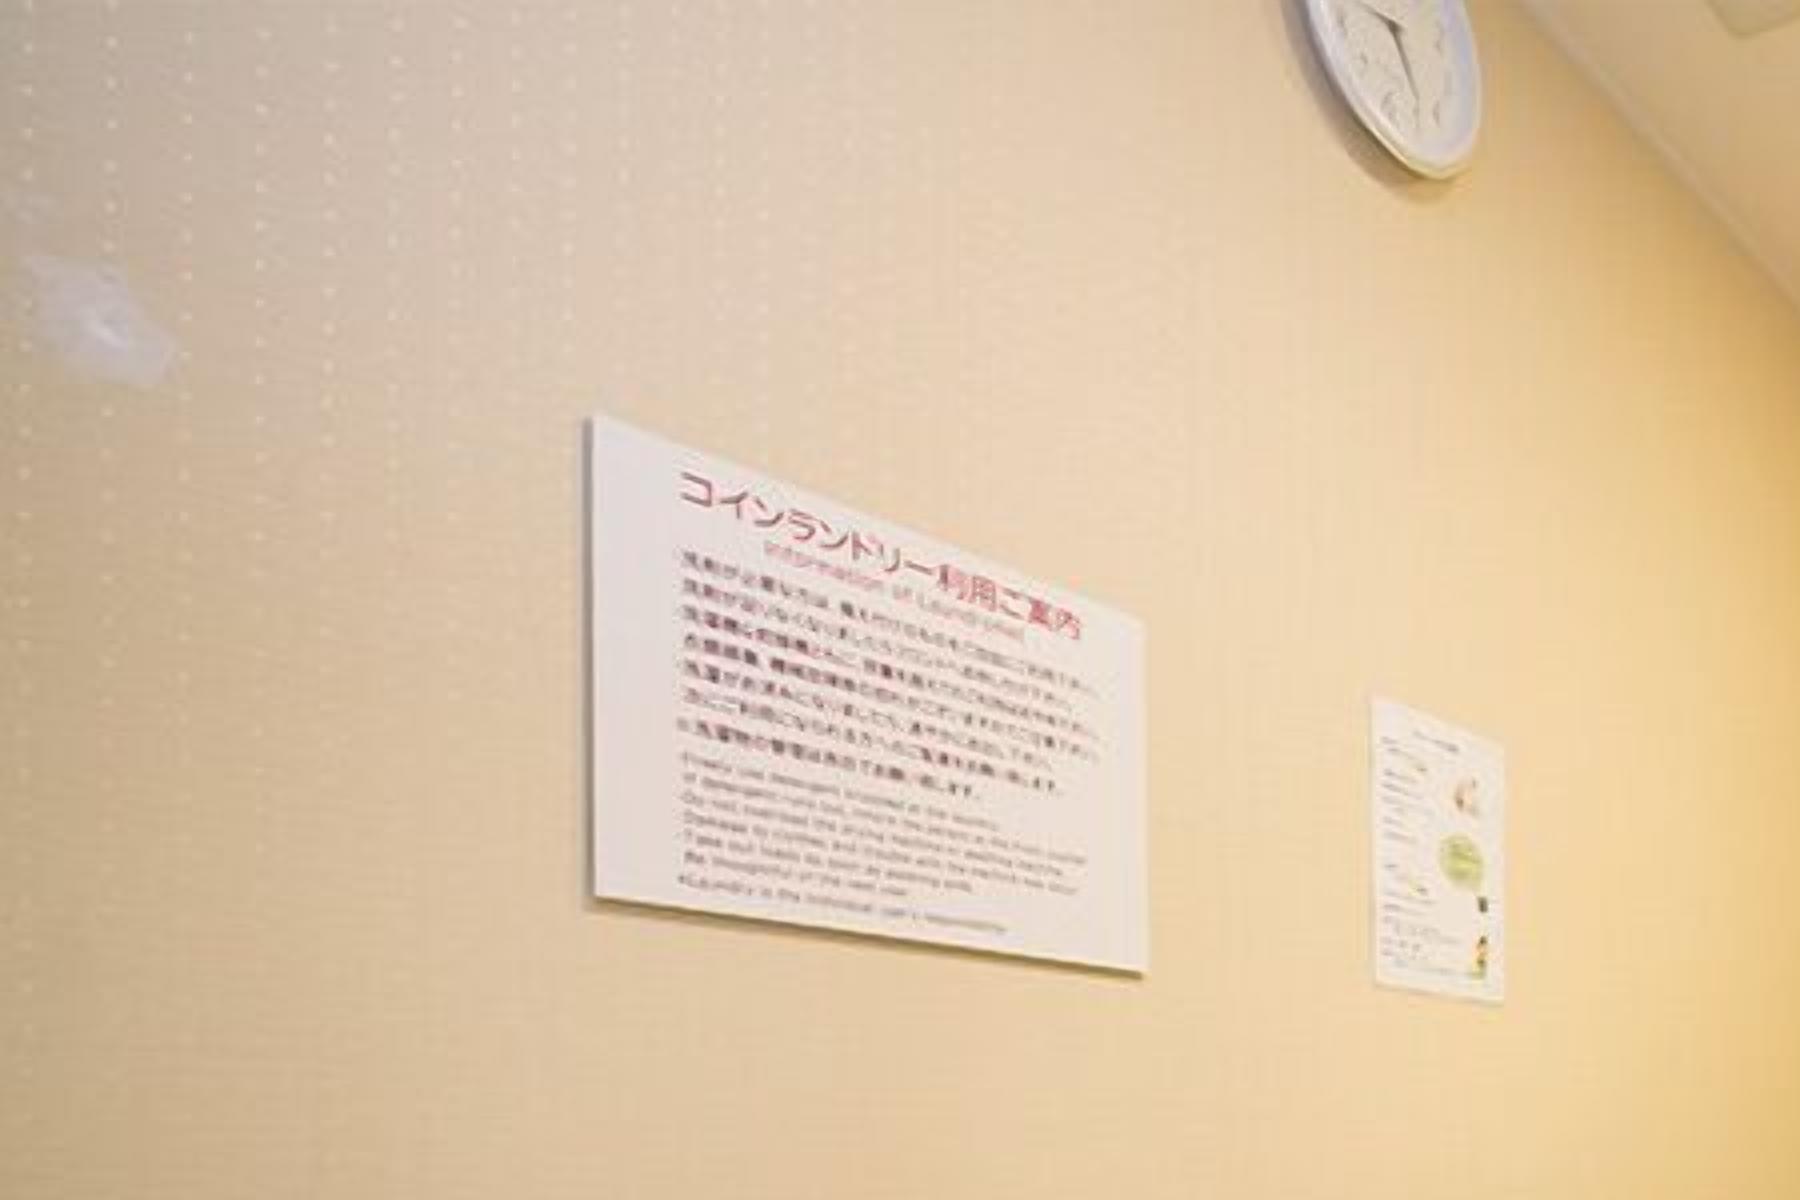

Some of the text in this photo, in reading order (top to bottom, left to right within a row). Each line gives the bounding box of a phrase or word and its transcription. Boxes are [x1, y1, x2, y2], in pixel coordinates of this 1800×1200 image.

[680, 471, 1082, 641] コインランドリー利用ご案内
